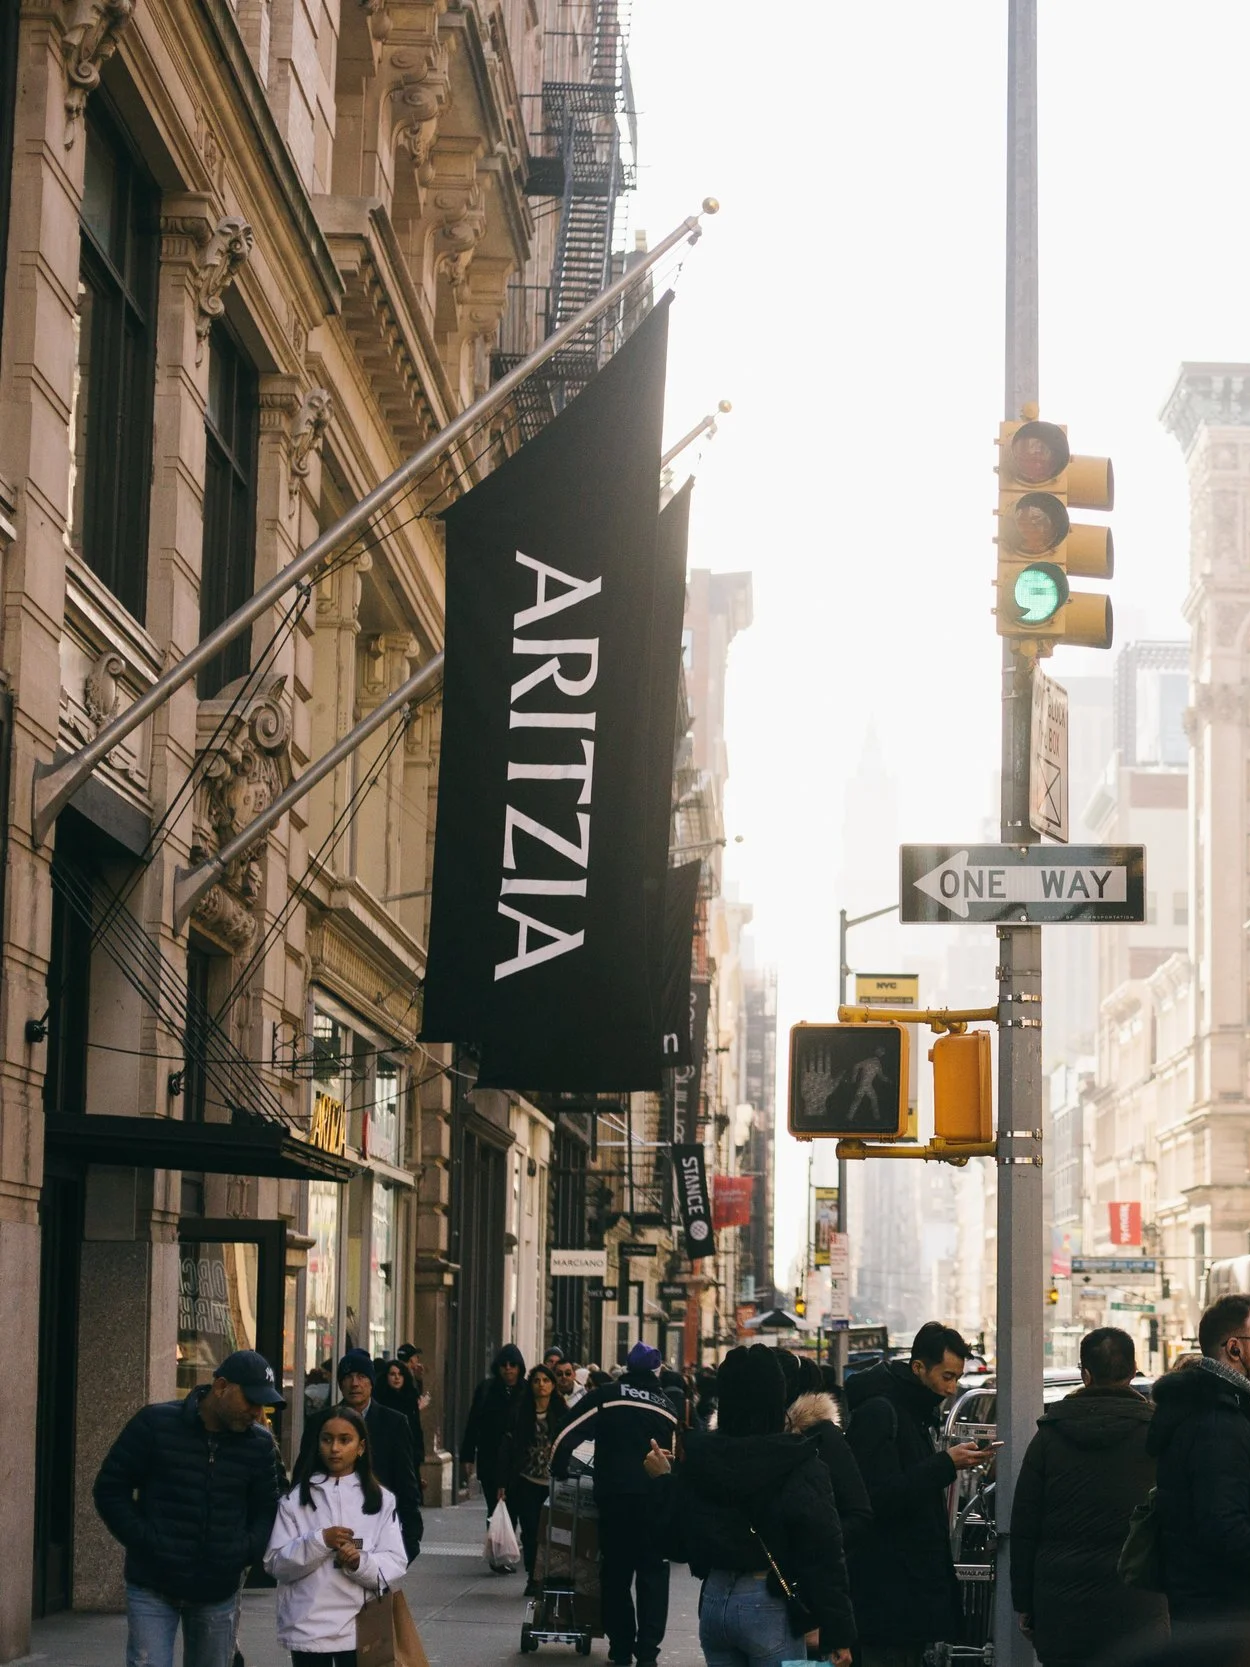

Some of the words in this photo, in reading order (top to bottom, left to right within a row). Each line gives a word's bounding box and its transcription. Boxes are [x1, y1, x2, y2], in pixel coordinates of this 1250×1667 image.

[494, 550, 602, 982] ARITZIA
[939, 869, 1007, 899] ONE
[1041, 870, 1112, 899] WAY
[876, 982, 897, 990] NYC
[682, 1156, 705, 1216] STANCE
[553, 1258, 604, 1268] MARCIANO
[620, 1384, 667, 1408] FedEx
